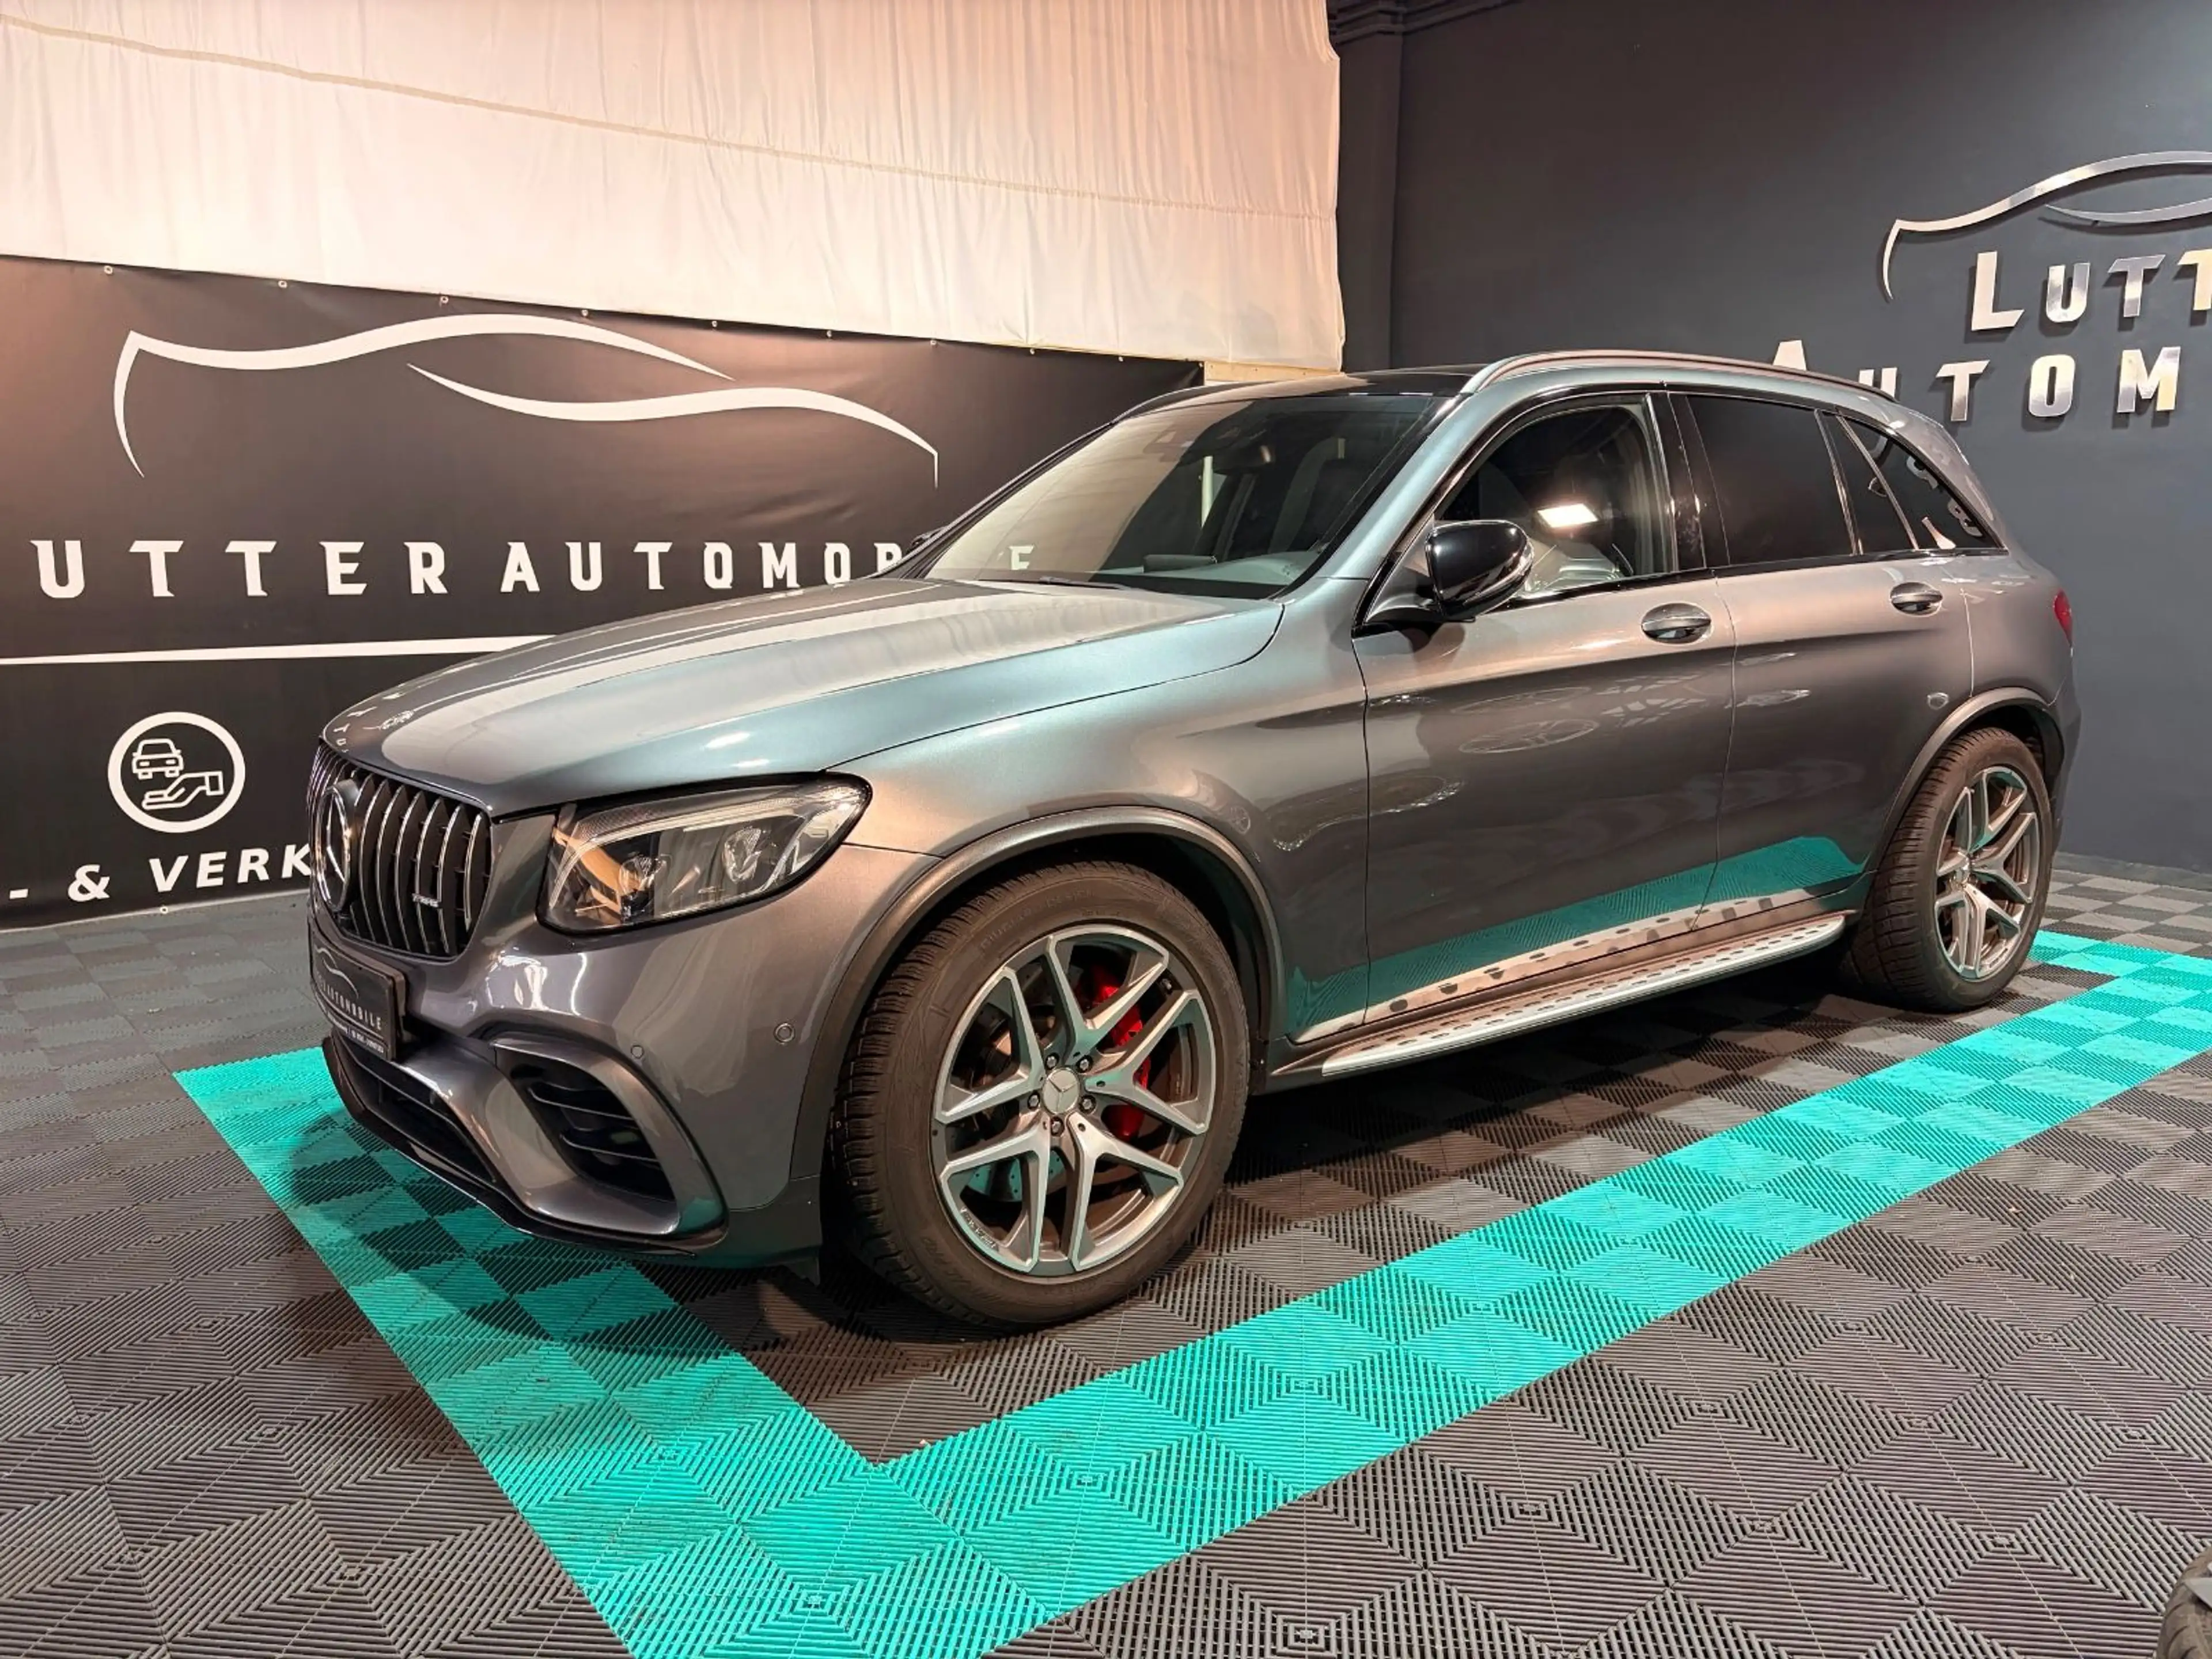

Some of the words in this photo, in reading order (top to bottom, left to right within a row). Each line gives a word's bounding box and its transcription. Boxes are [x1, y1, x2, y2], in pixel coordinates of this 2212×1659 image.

[29, 540, 448, 599] UTTER
[67, 864, 110, 902] &
[149, 843, 312, 892] VERK
